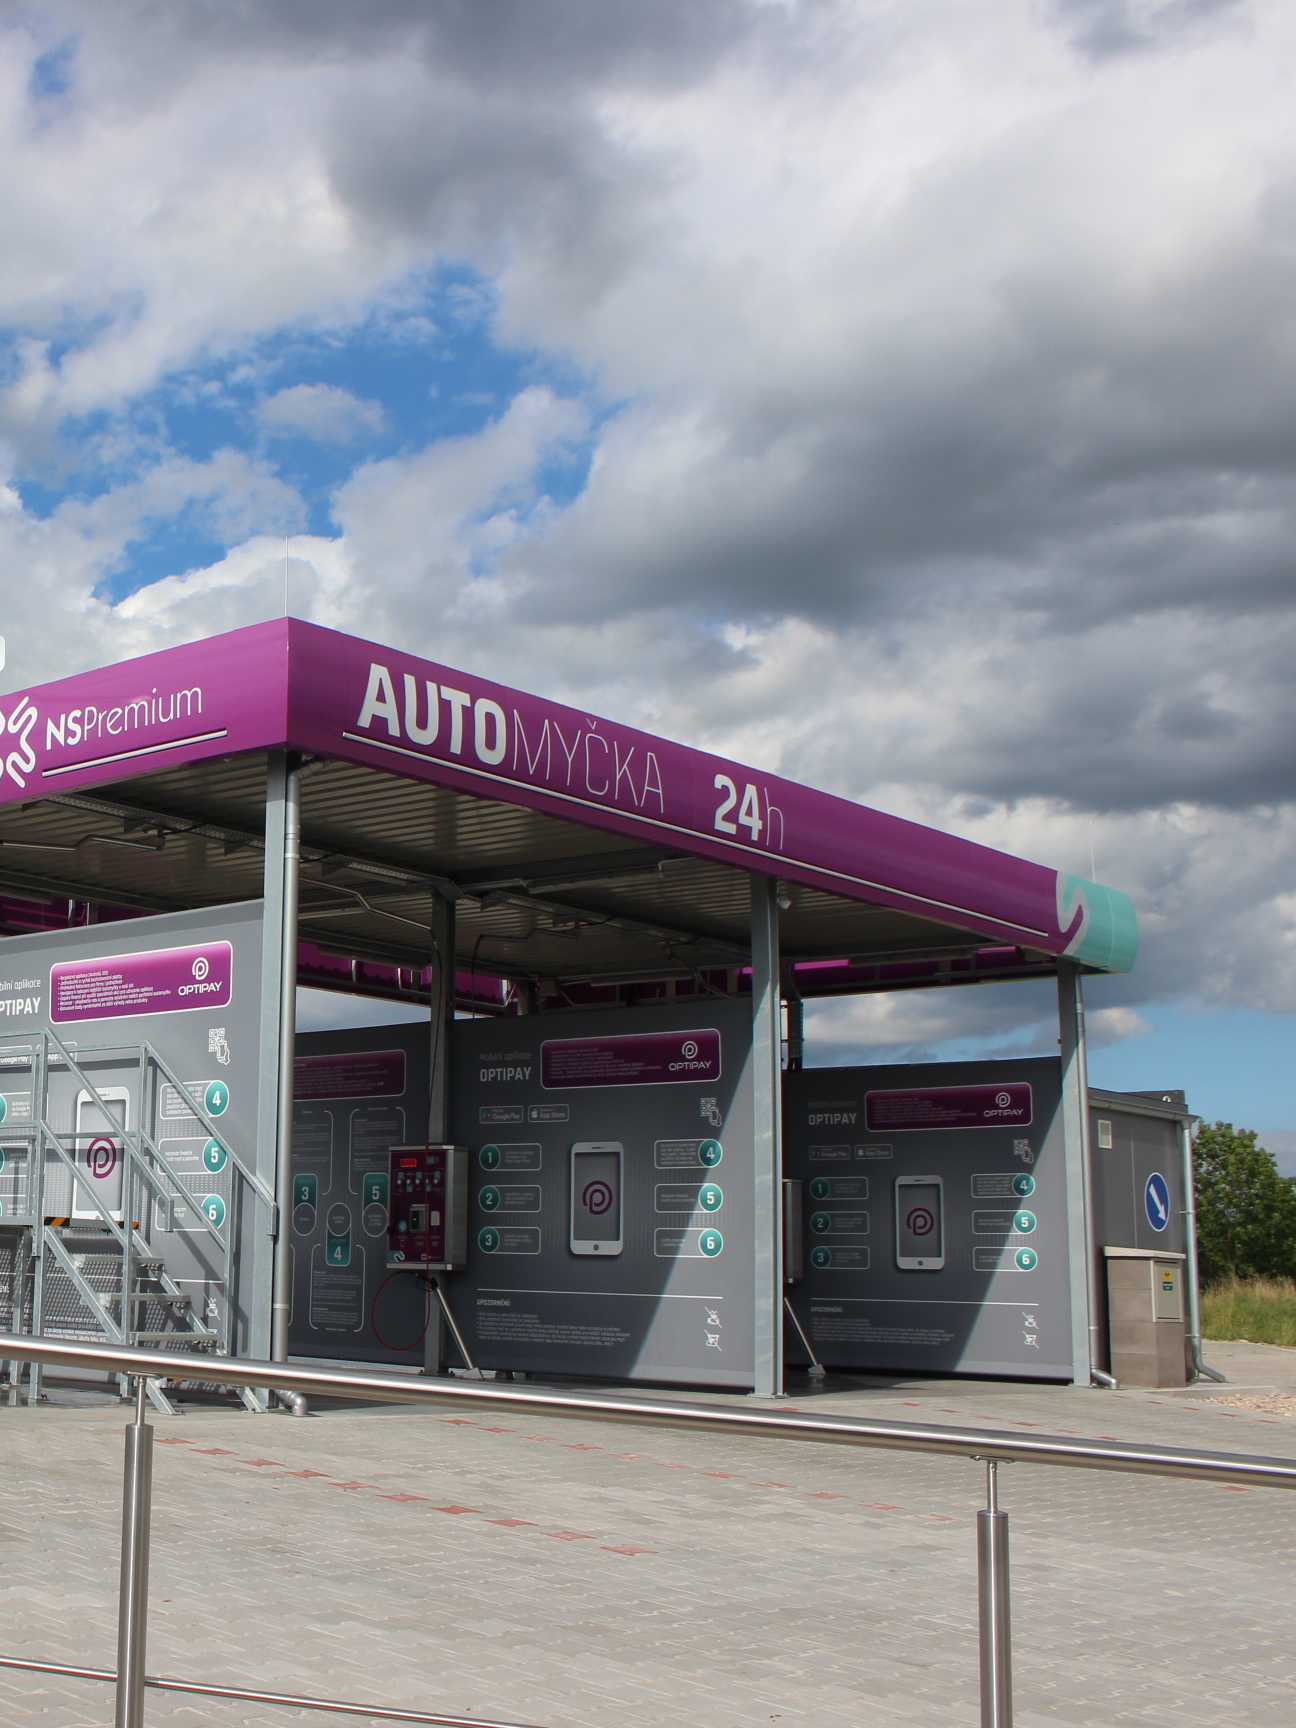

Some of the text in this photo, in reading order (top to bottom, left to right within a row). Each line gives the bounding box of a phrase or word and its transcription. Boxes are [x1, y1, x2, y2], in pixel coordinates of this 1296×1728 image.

[46, 687, 202, 750] NSPremium
[357, 662, 784, 850] AUTOMYČKA 24h
[14, 978, 41, 991] aplikace
[178, 981, 222, 996] OPTIPAY
[504, 1051, 532, 1062] aplikace
[669, 1061, 712, 1071] OPTIPAY
[480, 1067, 532, 1082] OPTIPAY
[212, 1090, 221, 1106] 4
[492, 1111, 521, 1121] Google Play
[540, 1110, 566, 1119] App Store
[808, 1112, 857, 1126] OPTIPAY
[983, 1109, 1023, 1117] OPTIPAY
[211, 1147, 219, 1164] 5
[488, 1151, 492, 1163] 1
[706, 1147, 715, 1159] 4
[817, 1184, 822, 1194] 1
[1019, 1180, 1028, 1191] 4
[301, 1186, 309, 1200] 3
[371, 1186, 380, 1200] 5
[486, 1193, 493, 1204] 2
[706, 1191, 715, 1204] 5
[208, 1204, 217, 1221] 6
[817, 1218, 824, 1228] 2
[1020, 1216, 1029, 1228] 5
[485, 1234, 492, 1246] 3
[706, 1236, 715, 1249] 6
[334, 1246, 342, 1261] 4
[817, 1252, 824, 1263] 3
[1022, 1254, 1030, 1265] 6
